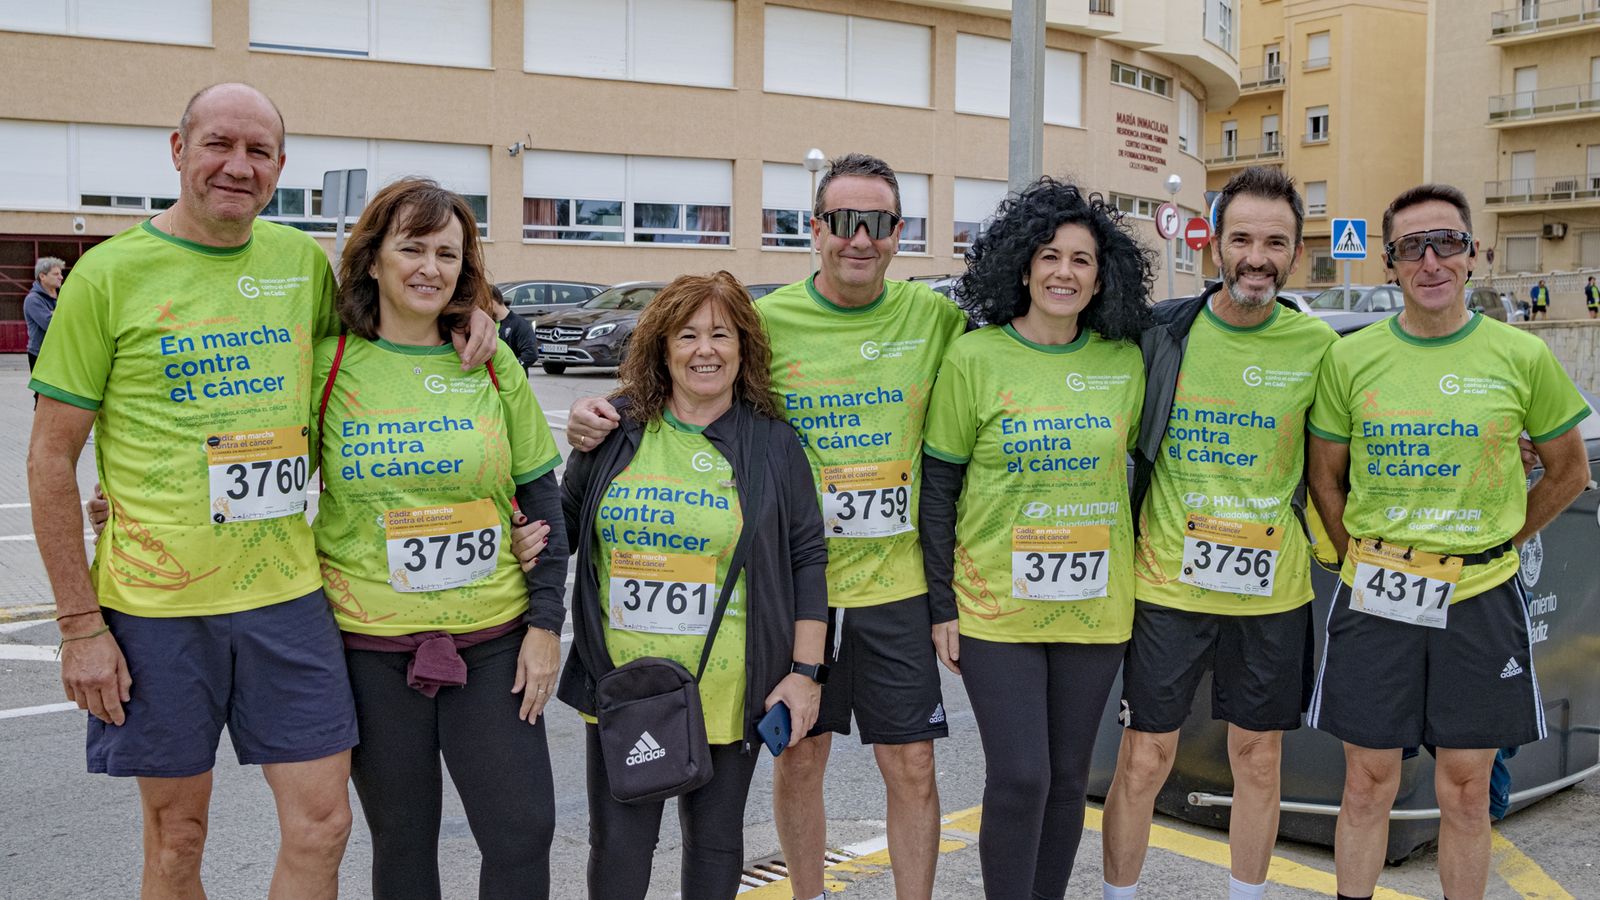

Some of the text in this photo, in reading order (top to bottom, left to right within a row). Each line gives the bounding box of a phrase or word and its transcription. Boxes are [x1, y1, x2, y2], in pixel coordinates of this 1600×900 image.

[161, 326, 290, 355] En marcha
[165, 354, 250, 378] contra
[171, 376, 284, 402] el cáncer
[786, 387, 902, 410] En marcha
[343, 416, 473, 436] En marcha
[789, 412, 860, 430] contra
[1002, 414, 1111, 434] En marcha
[1196, 410, 1275, 428] marcha
[1364, 420, 1478, 437] En marcha
[817, 431, 891, 449] cáncer
[1003, 435, 1071, 454] contra
[1168, 427, 1229, 444] contra
[342, 439, 424, 457] contra
[1169, 444, 1256, 466] el cáncer
[1368, 440, 1429, 456] contra
[342, 458, 463, 480] el cáncer
[1008, 454, 1098, 472] el cáncer
[1368, 459, 1459, 476] el cáncer
[226, 456, 306, 500] 3760
[636, 488, 728, 509] marcha
[836, 487, 908, 520] 3759
[1214, 496, 1280, 508] HYUNDAI
[601, 505, 674, 524] contra
[1056, 502, 1119, 516] HYUNDAI
[1411, 509, 1481, 521] HYUNDAI
[1218, 520, 1243, 529] marcha
[602, 524, 709, 551] el cáncer
[403, 528, 496, 572] 3758
[1194, 541, 1273, 578] 3756
[1025, 551, 1105, 582] 3757
[623, 579, 707, 615] 3761
[1367, 568, 1450, 609] 4311
[1531, 620, 1549, 644] ádiz
[1500, 666, 1523, 678] adidas
[626, 748, 665, 766] adidas
